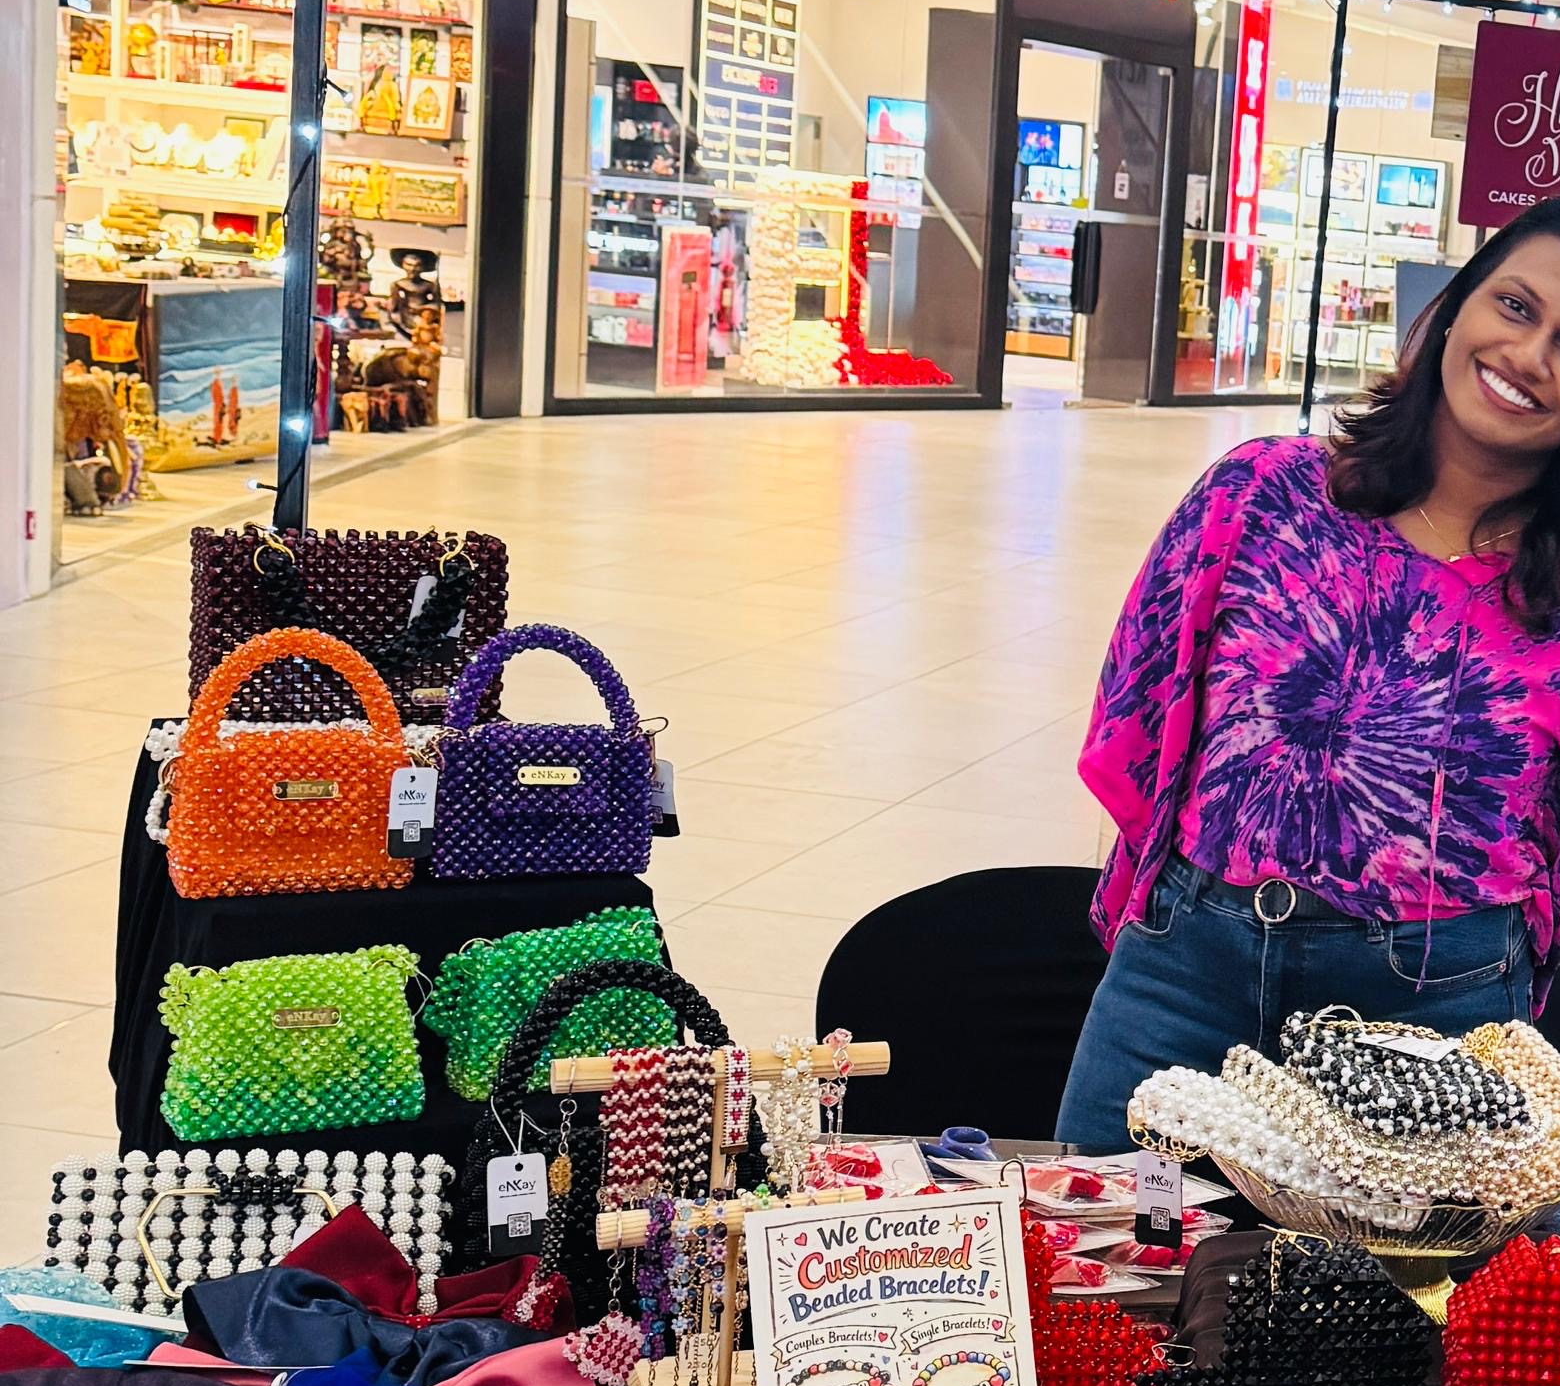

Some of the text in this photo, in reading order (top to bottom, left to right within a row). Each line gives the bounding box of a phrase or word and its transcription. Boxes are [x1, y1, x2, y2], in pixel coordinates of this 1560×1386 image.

[1488, 190, 1536, 207] CAKES
[530, 771, 567, 781] eNKay
[398, 790, 428, 802] eNKay
[498, 1179, 536, 1192] eNKay
[1144, 1174, 1174, 1190] eNKay
[817, 1214, 940, 1250] We Create
[797, 1234, 972, 1290] Customized
[788, 1270, 990, 1322] Beaded Bracelets!
[910, 1315, 990, 1344] Single Bracelets!
[786, 1330, 877, 1354] Couples Bracelets!
